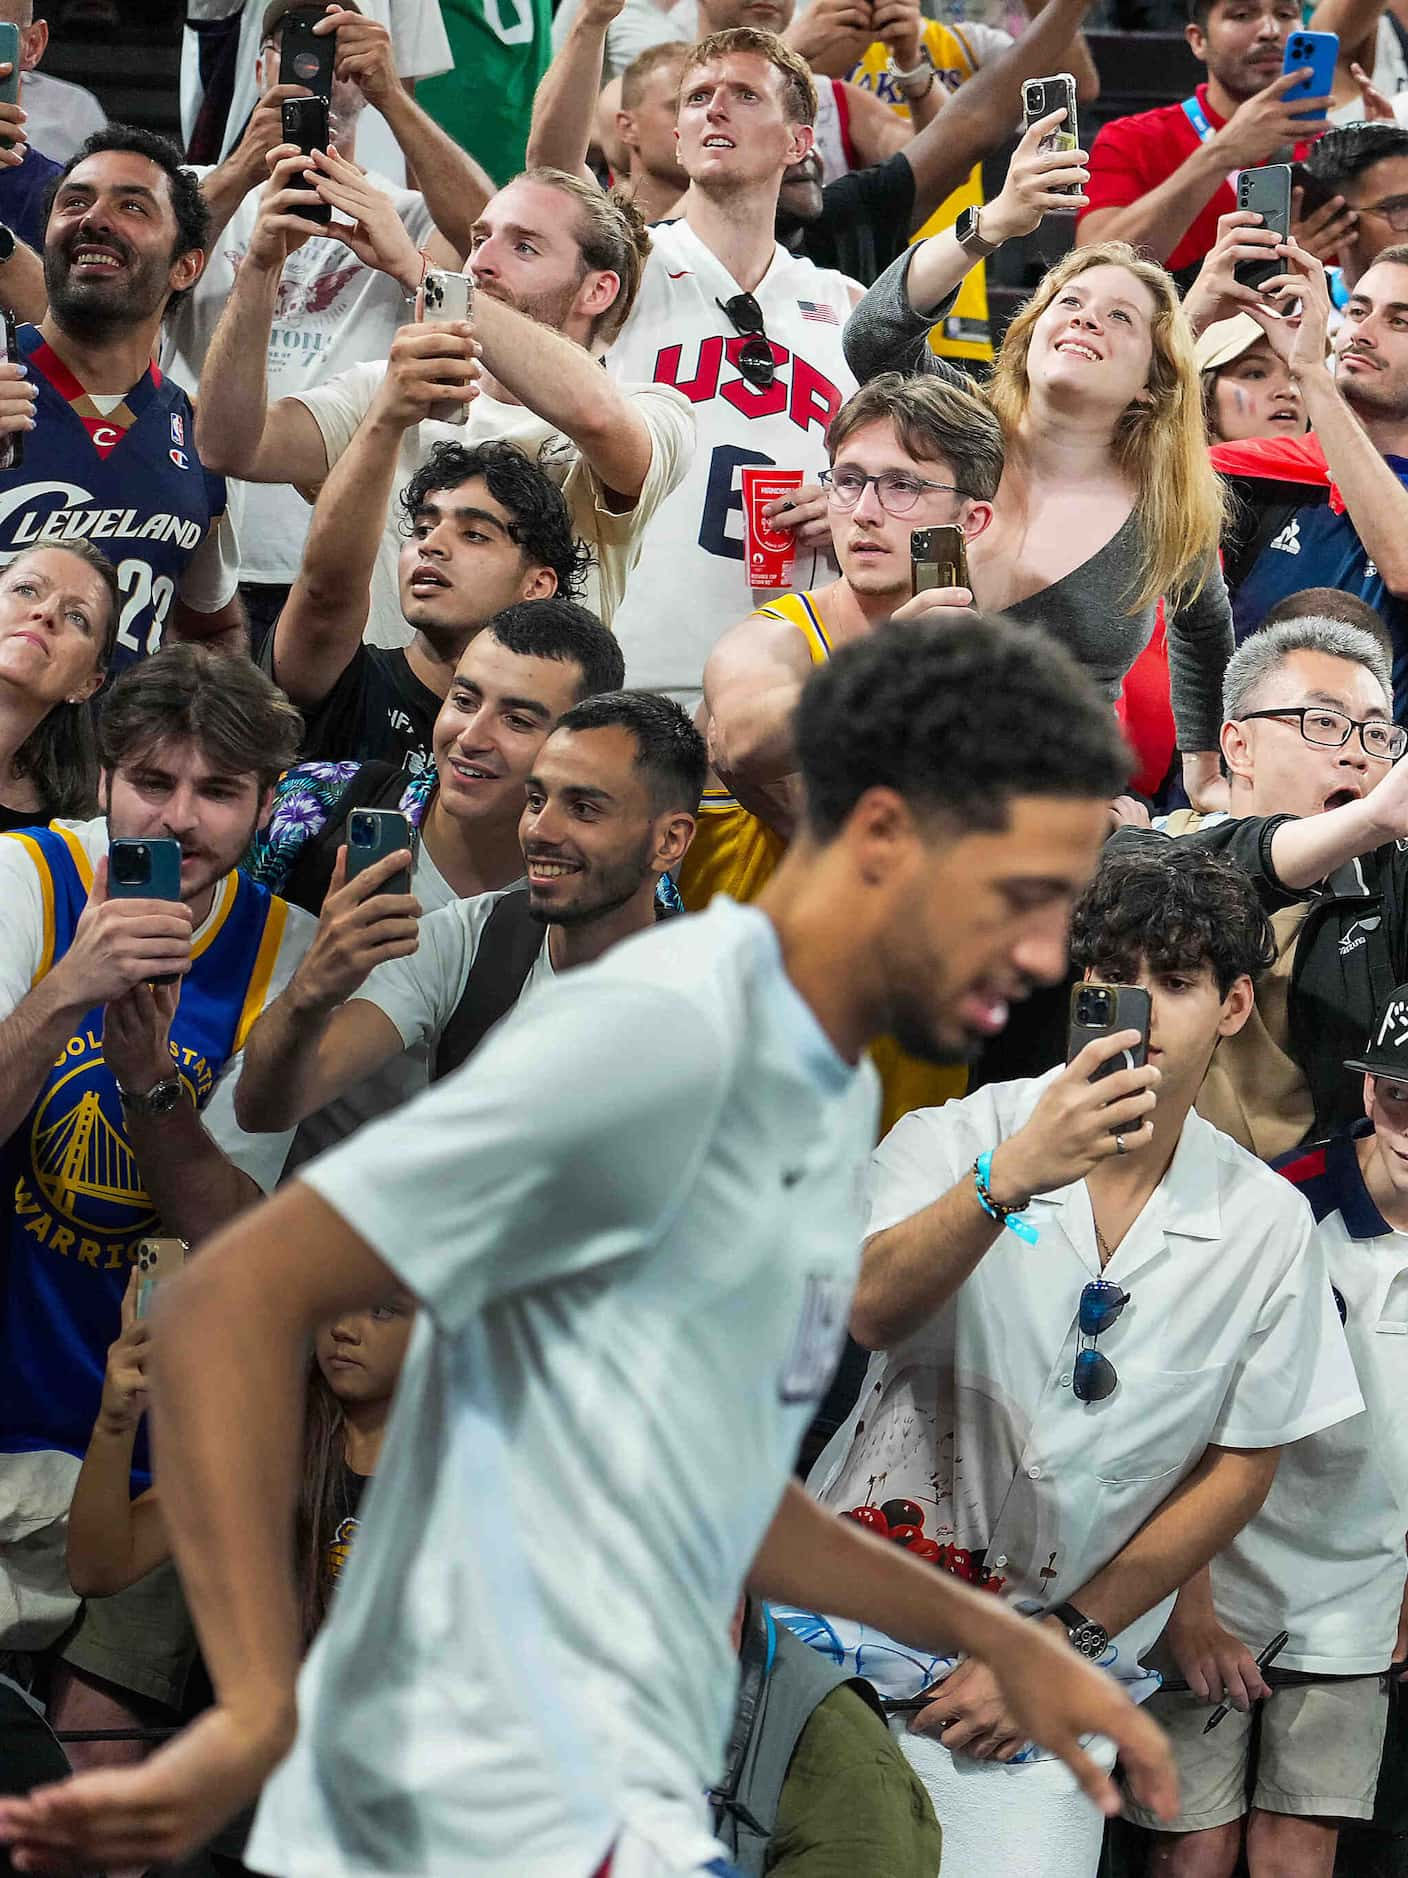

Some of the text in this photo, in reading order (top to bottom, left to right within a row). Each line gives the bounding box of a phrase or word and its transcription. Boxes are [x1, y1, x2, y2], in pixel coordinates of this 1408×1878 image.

[653, 335, 843, 448] USA
[0, 481, 201, 566] CLEVELAND
[170, 1040, 213, 1096] STATE
